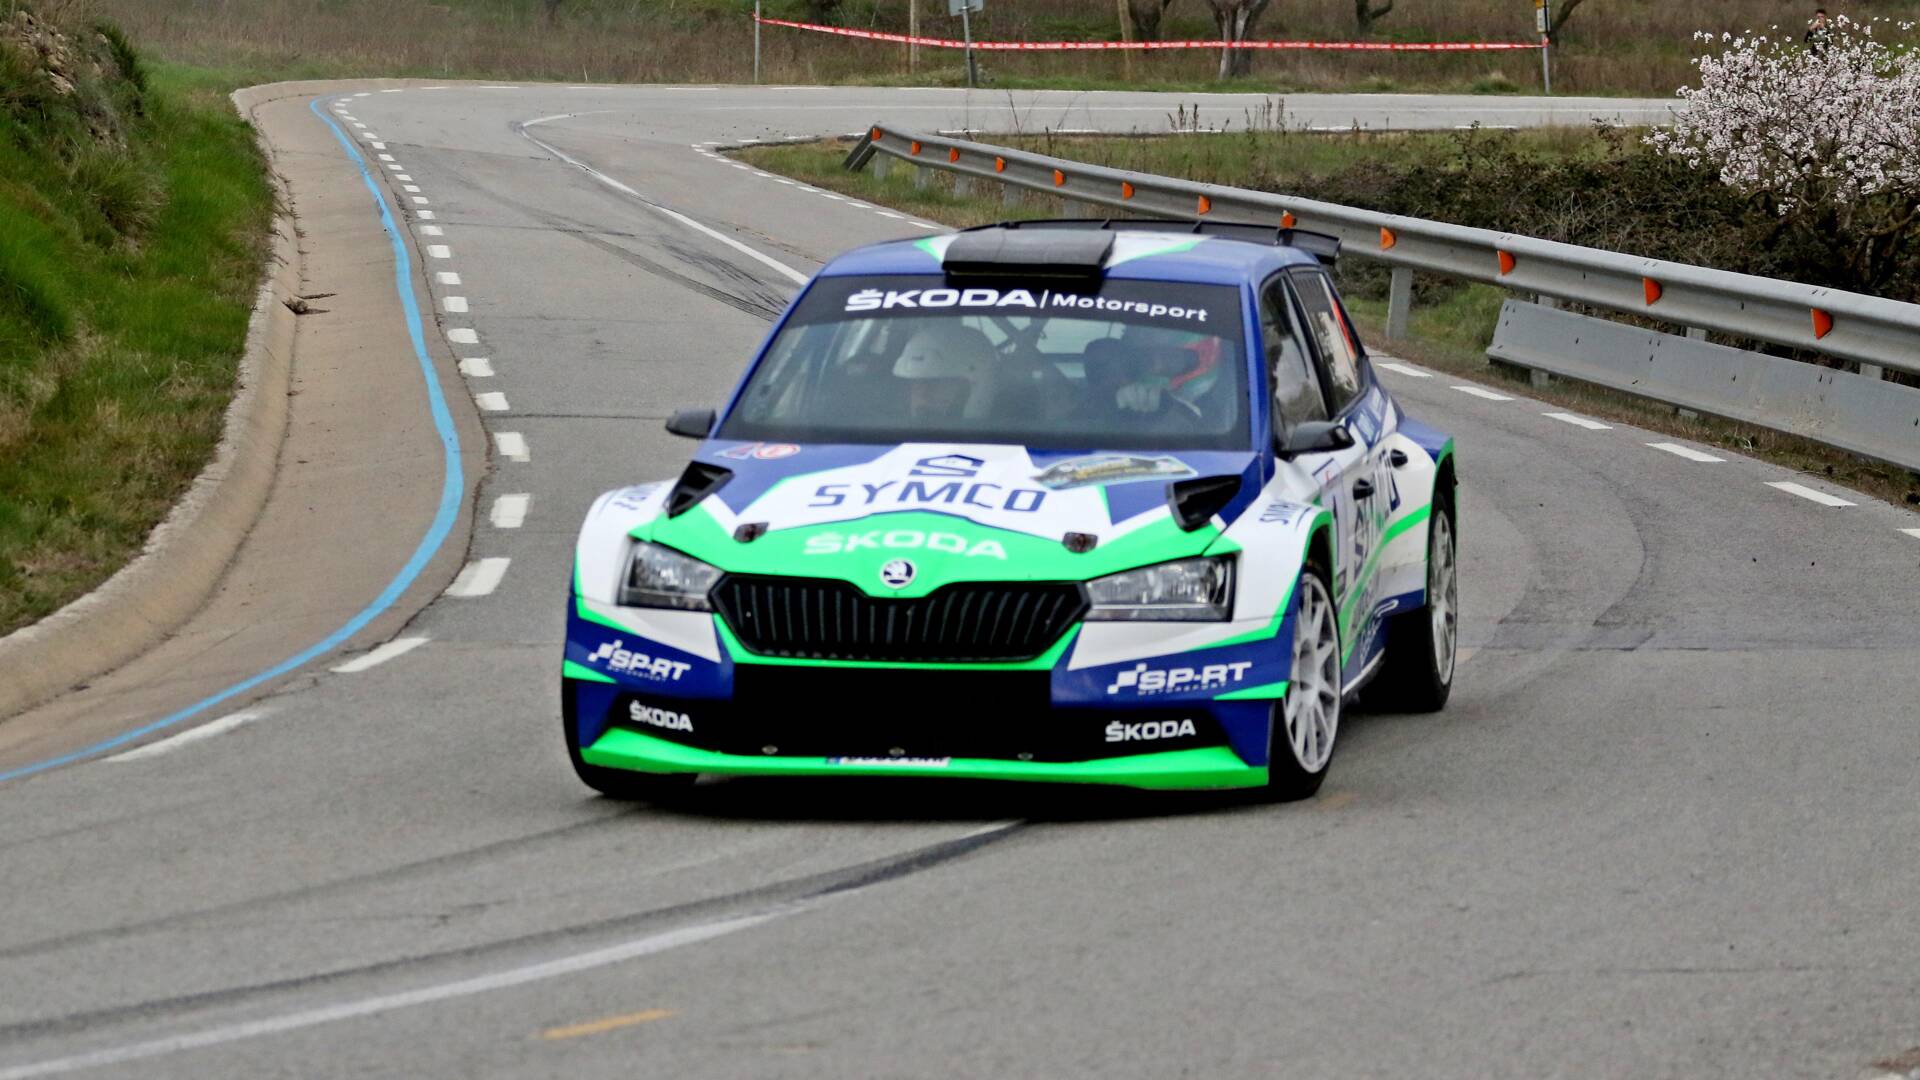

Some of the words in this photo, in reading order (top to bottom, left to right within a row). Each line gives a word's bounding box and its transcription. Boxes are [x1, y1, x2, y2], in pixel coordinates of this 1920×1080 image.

[844, 288, 1037, 312] ŠKODA
[1051, 293, 1209, 323] Motorsport
[807, 480, 1047, 514] SYMCO
[803, 530, 1008, 560] ŠKODA
[629, 699, 694, 732] ŠKODA
[1105, 719, 1197, 743] ŠKODA
